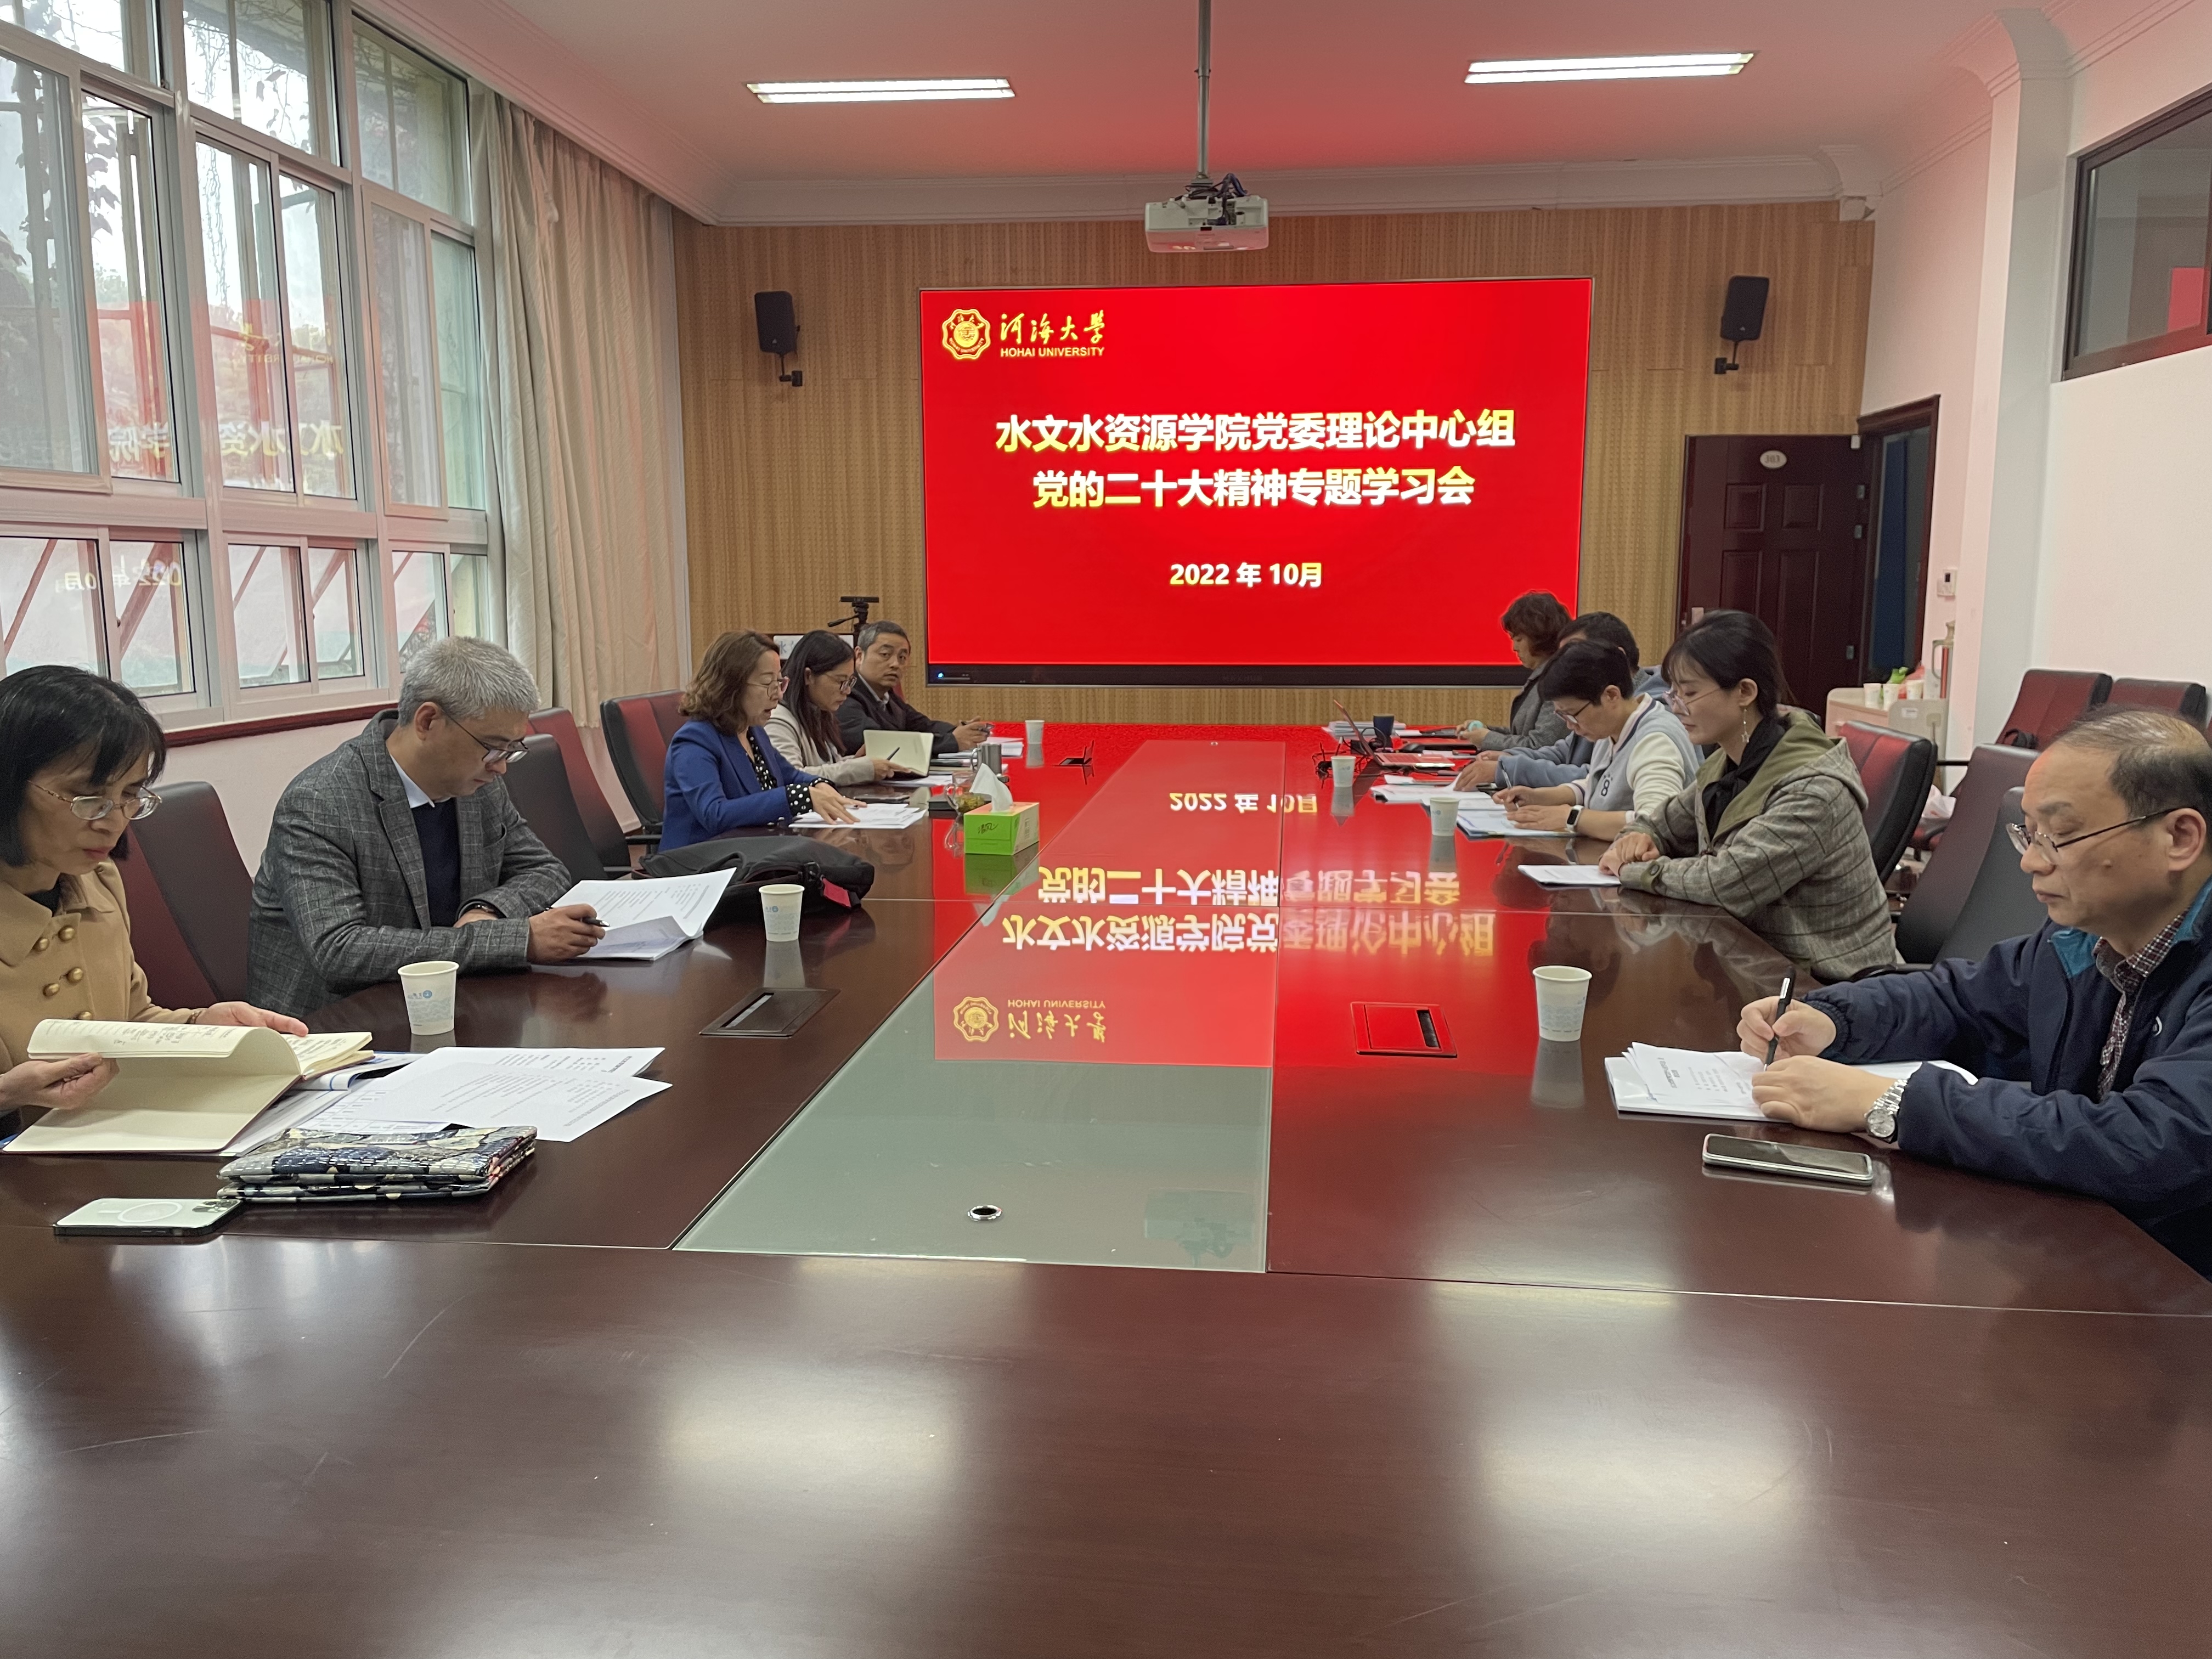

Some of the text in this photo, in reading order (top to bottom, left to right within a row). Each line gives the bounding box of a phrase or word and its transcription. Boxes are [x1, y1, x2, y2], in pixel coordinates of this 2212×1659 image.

[1000, 347, 1104, 357] HOHAI UNIVERSITY
[996, 409, 1516, 453] 水文水资源学院党委理论中心组
[1032, 466, 1476, 508] 党的二十大精神专题学习会
[1170, 562, 1322, 588] 2022 年 10月
[1600, 779, 1610, 797] 8
